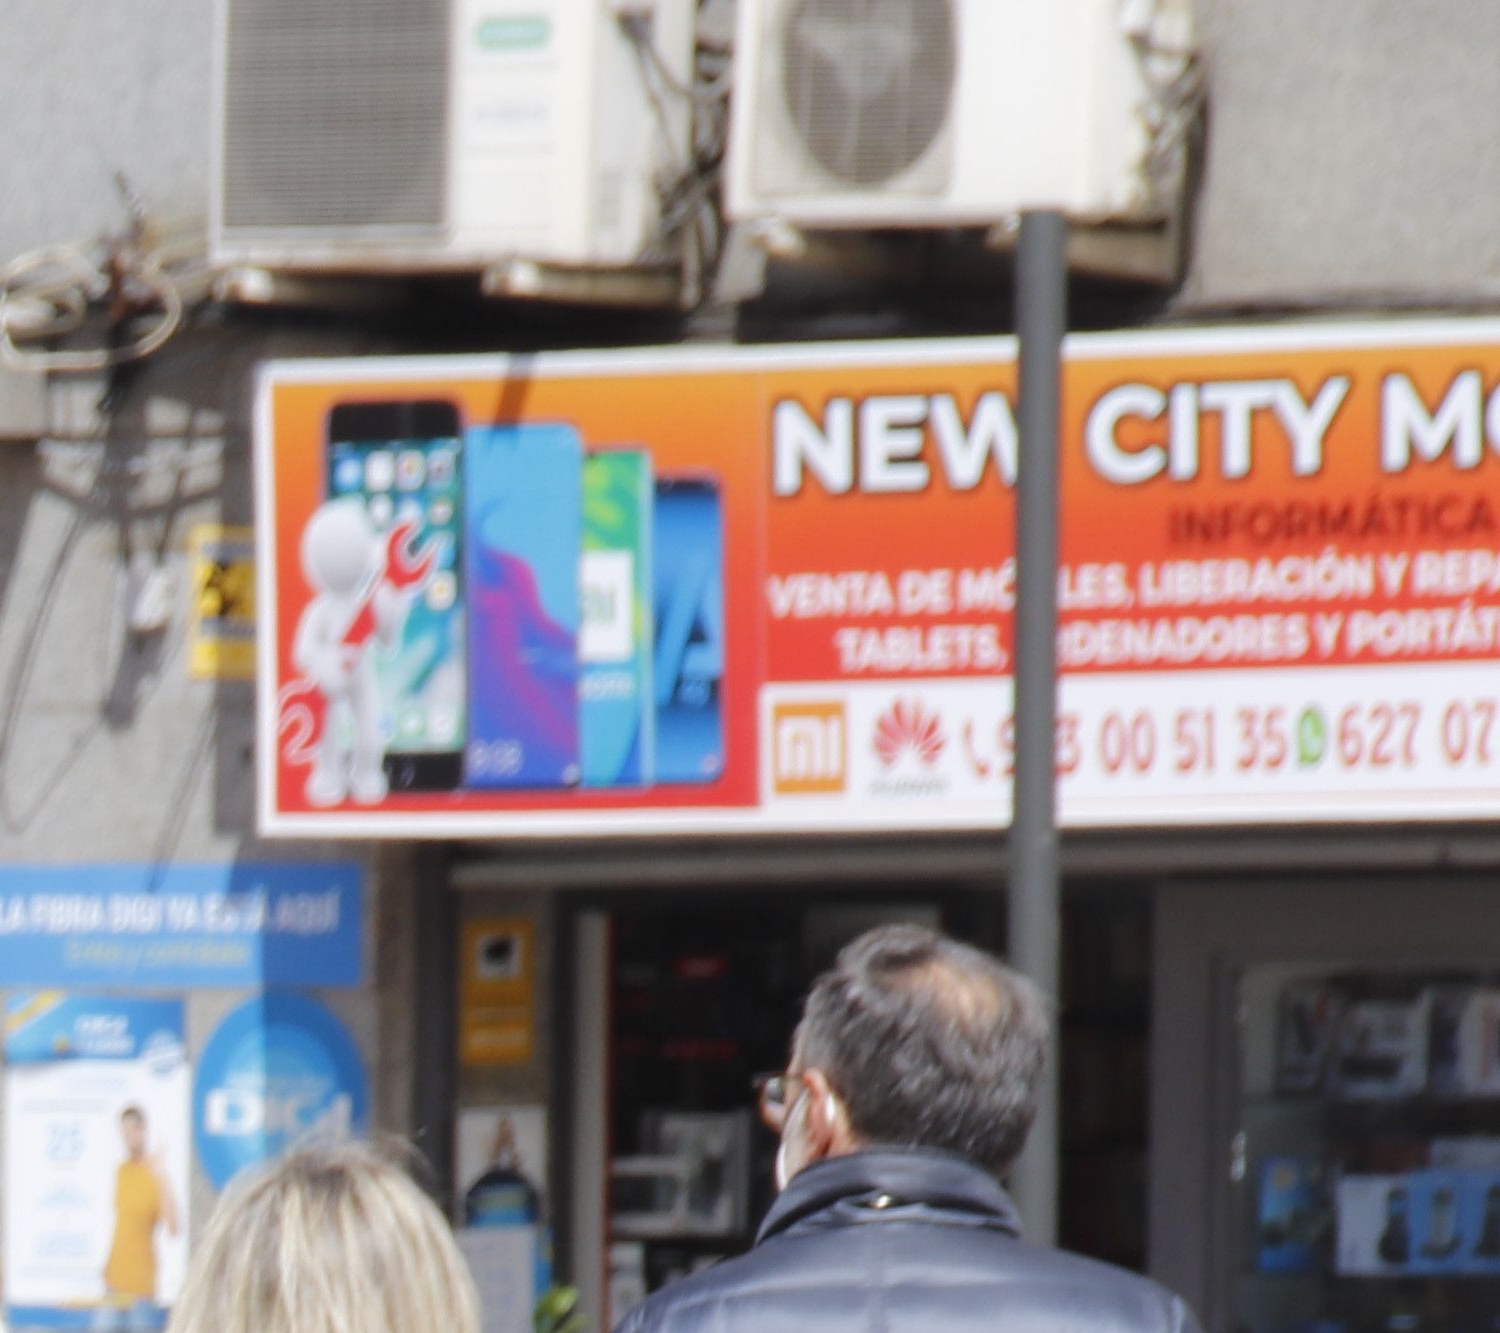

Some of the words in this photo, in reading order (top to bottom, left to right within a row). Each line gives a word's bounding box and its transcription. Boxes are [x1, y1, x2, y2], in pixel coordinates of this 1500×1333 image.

[773, 390, 1017, 497] NEW
[1085, 375, 1350, 484] CITY
[1167, 495, 1495, 547] INFORMÁTICA
[768, 572, 893, 618] VENTA
[899, 570, 953, 615] DE
[1140, 545, 1374, 607] LIBERACIÓN
[1379, 552, 1407, 599] Y
[835, 624, 1008, 673] TABLETS,
[1312, 612, 1344, 657] Y
[1099, 707, 1156, 774] 00
[1173, 705, 1218, 773] 51
[1235, 705, 1288, 770] 35
[1338, 700, 1421, 768] 627
[1442, 698, 1497, 765] 07
